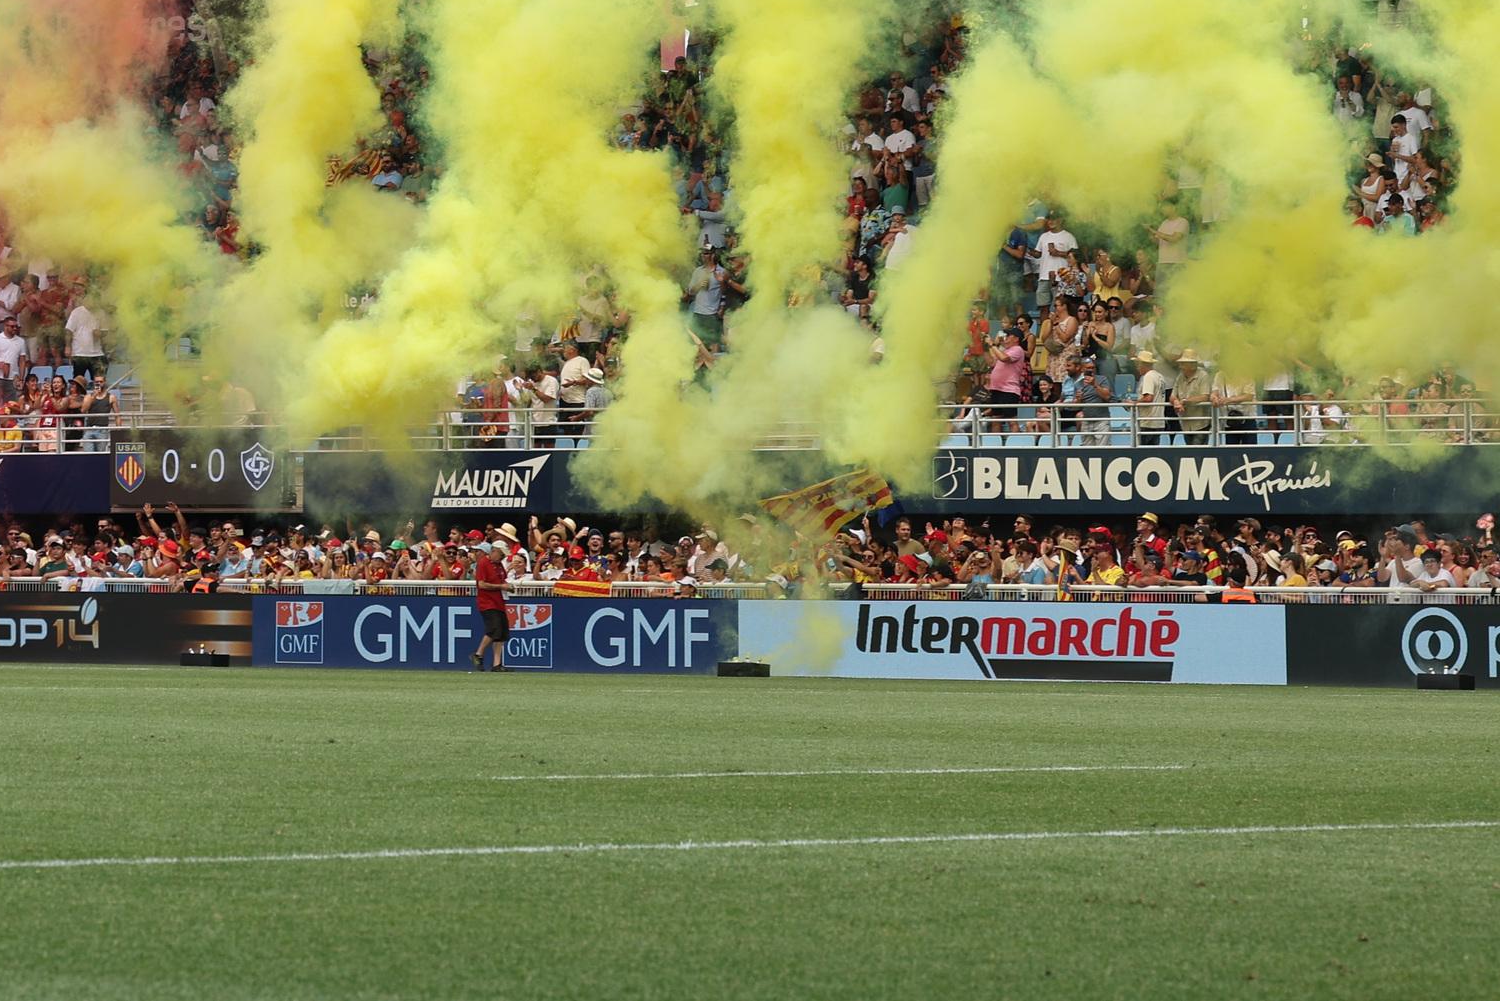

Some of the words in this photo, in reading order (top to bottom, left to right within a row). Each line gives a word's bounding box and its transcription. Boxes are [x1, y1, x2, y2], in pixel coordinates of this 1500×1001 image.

[117, 444, 144, 452] USAP
[162, 449, 180, 483] 0
[207, 448, 225, 483] 0
[973, 456, 1228, 502] BLANCOM
[435, 468, 531, 497] MAURIN
[435, 499, 511, 507] AUTOMOBILES
[280, 633, 320, 654] GMF
[353, 604, 473, 664] GMF
[506, 637, 548, 658] GMF
[584, 606, 710, 668] GMF
